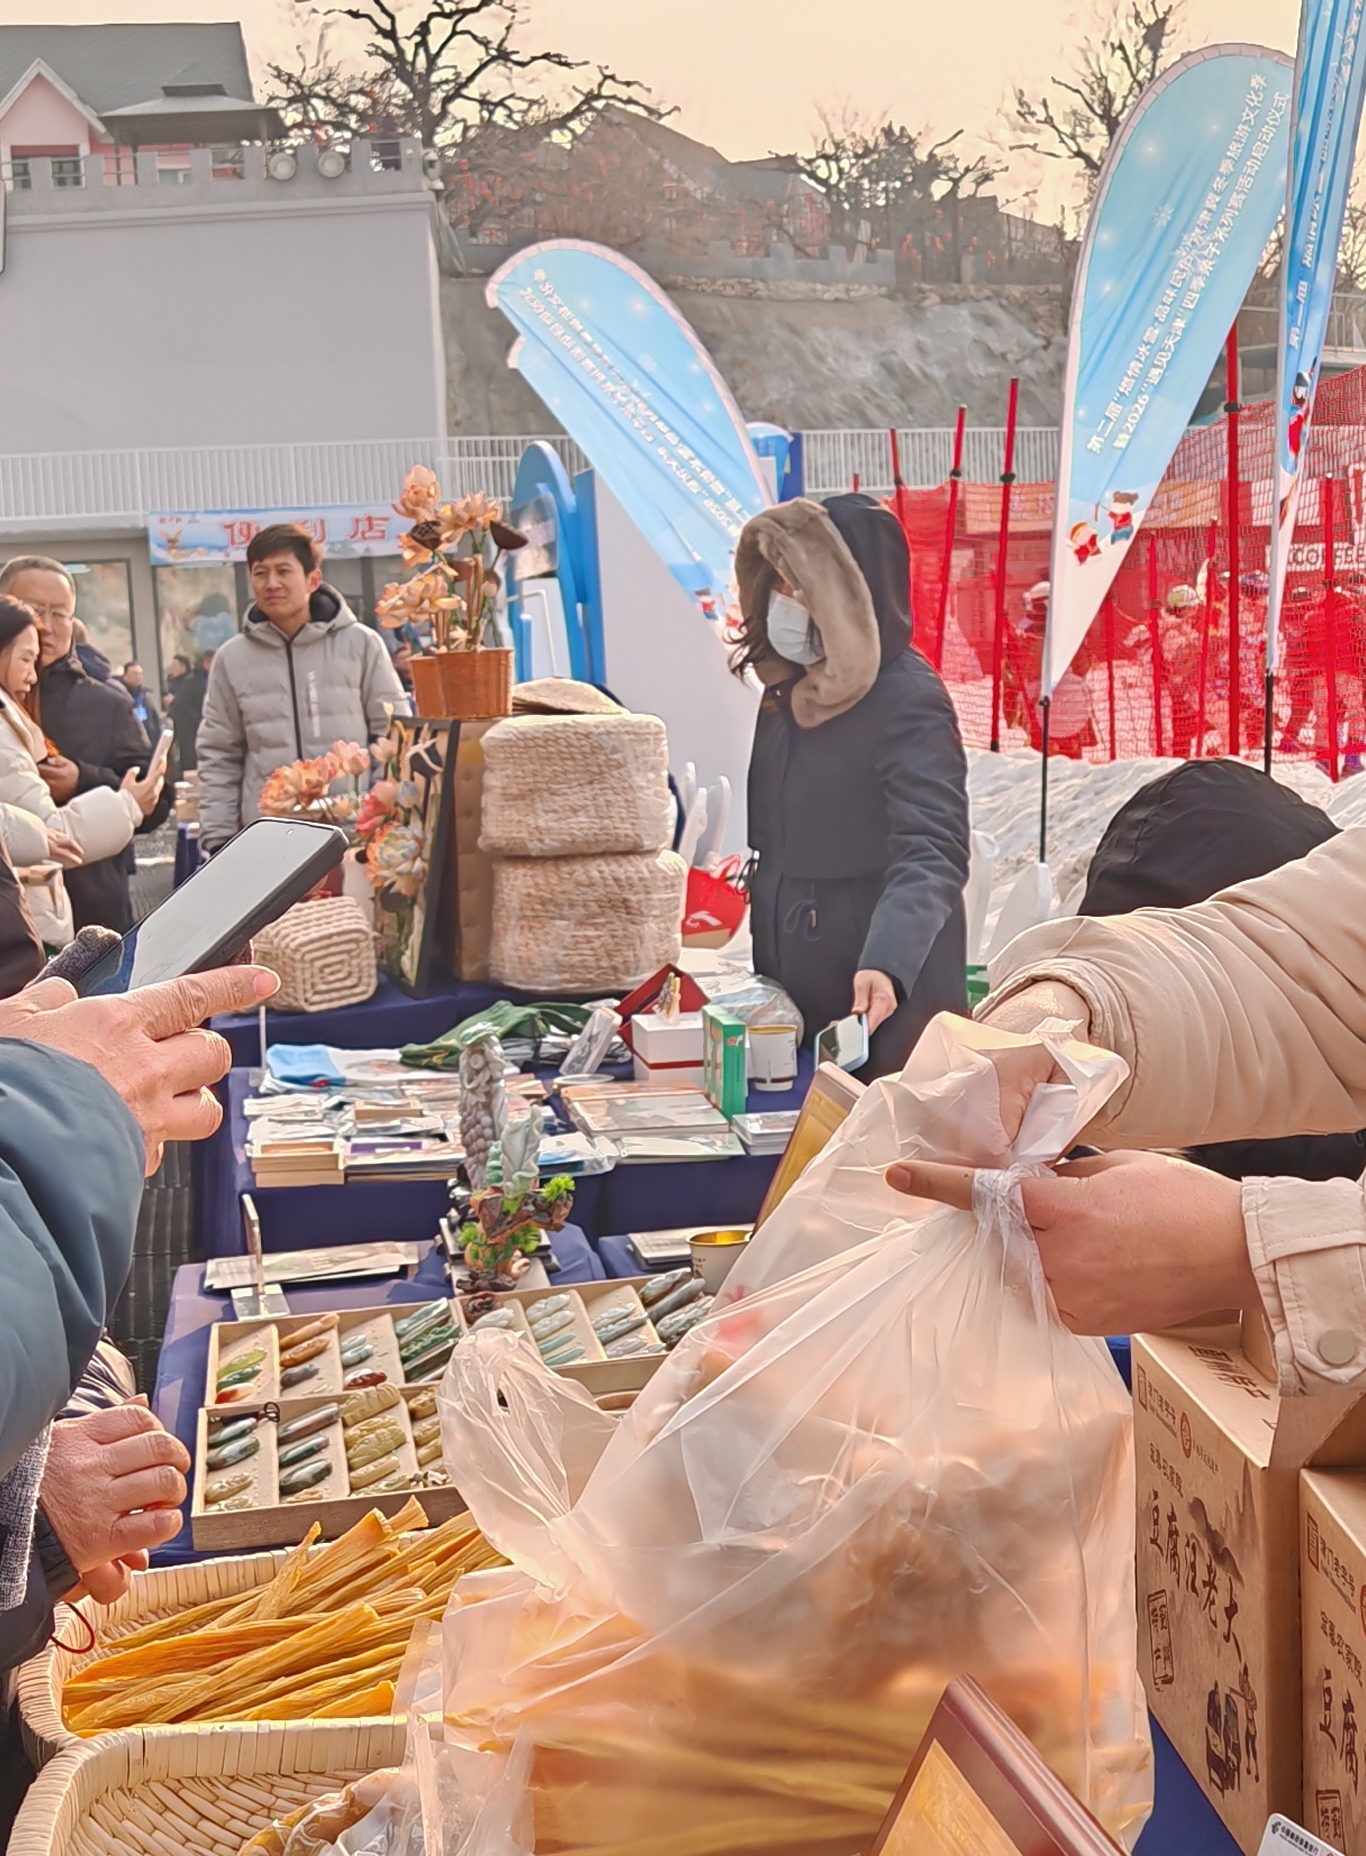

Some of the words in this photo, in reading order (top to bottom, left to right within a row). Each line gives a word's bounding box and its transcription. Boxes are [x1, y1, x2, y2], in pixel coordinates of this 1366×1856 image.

[1292, 546, 1366, 566] COFEE
[1149, 1487, 1243, 1663] 豆腐汪老大
